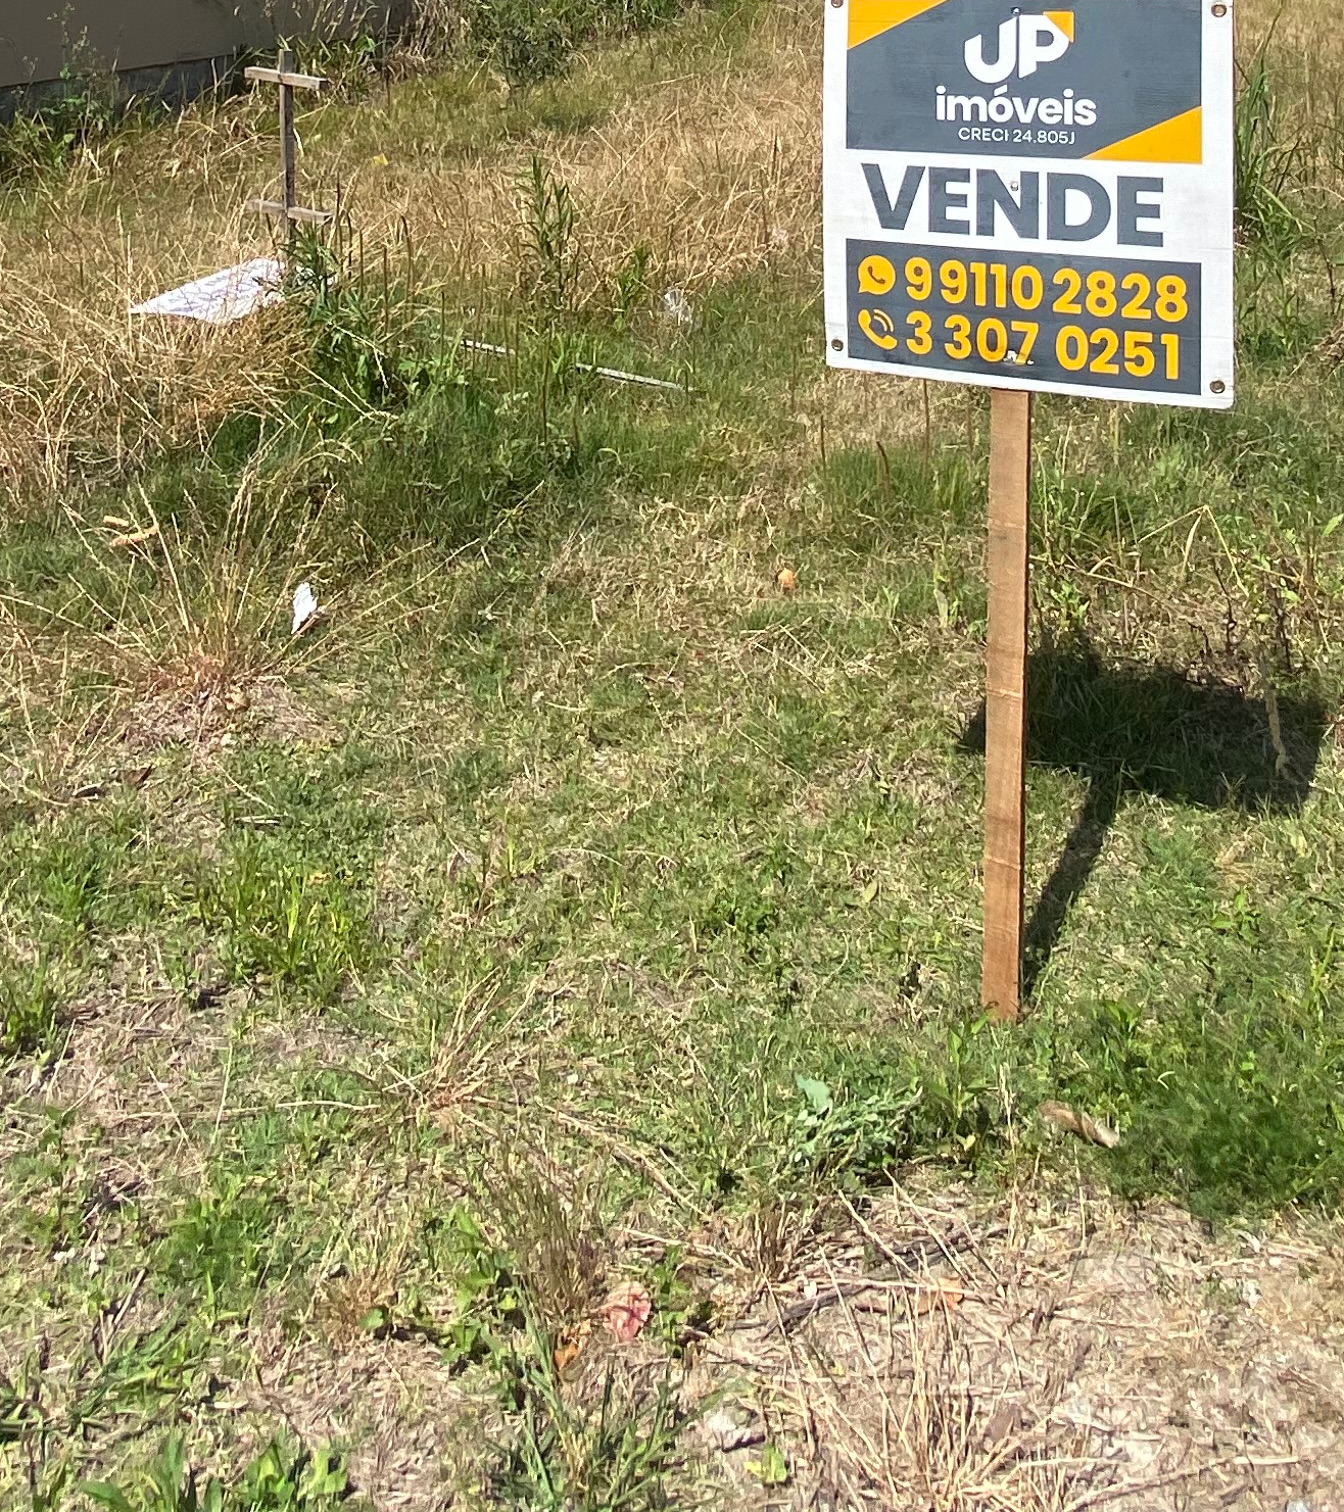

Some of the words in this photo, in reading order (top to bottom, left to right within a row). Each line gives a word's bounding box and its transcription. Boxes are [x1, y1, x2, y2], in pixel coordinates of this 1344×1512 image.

[964, 11, 1074, 84] UP
[935, 84, 1097, 126] imóveis
[861, 162, 1164, 247] VENDE
[939, 259, 1043, 310] 9110
[1052, 267, 1188, 323] 2828
[944, 314, 1040, 365] 307
[1056, 325, 1179, 380] 0251
